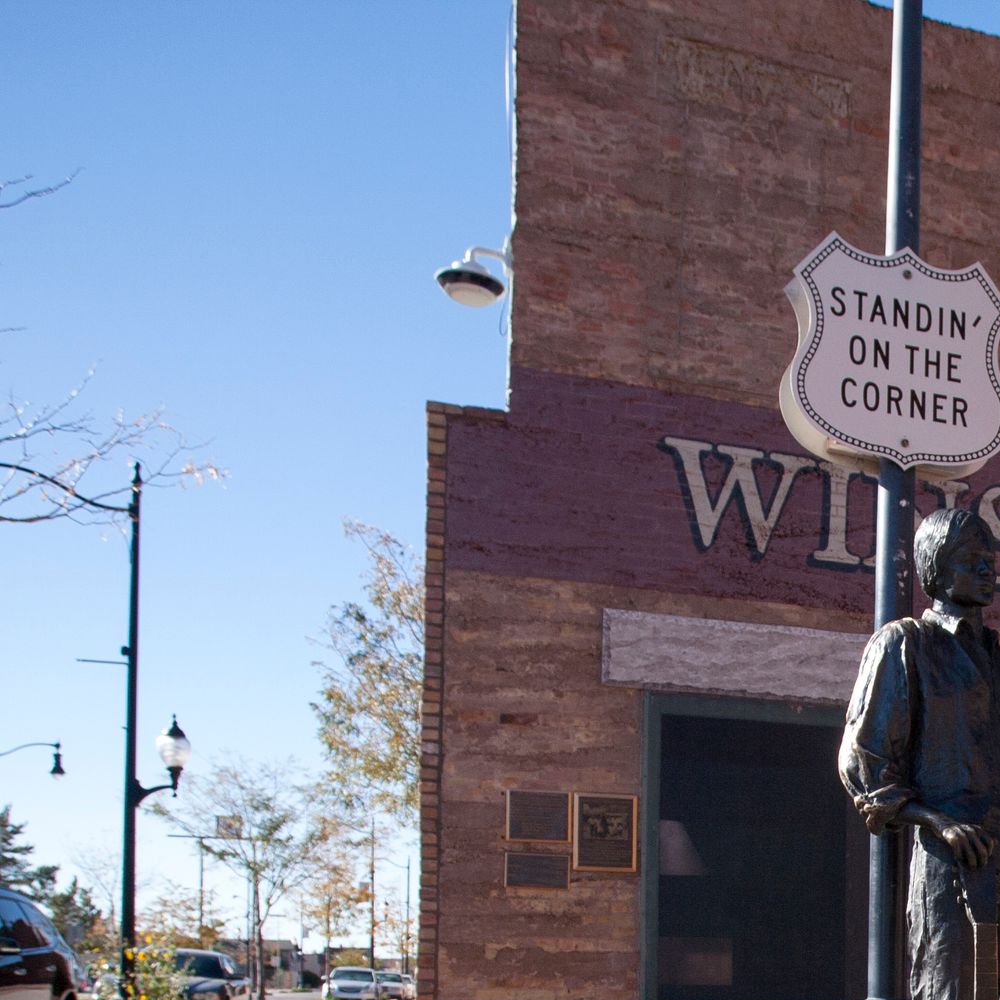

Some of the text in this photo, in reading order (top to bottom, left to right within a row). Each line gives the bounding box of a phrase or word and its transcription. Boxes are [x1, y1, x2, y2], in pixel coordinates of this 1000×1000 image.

[830, 286, 982, 341] STANDIN'
[849, 335, 962, 383] ON THE
[840, 377, 968, 428] CORNER
